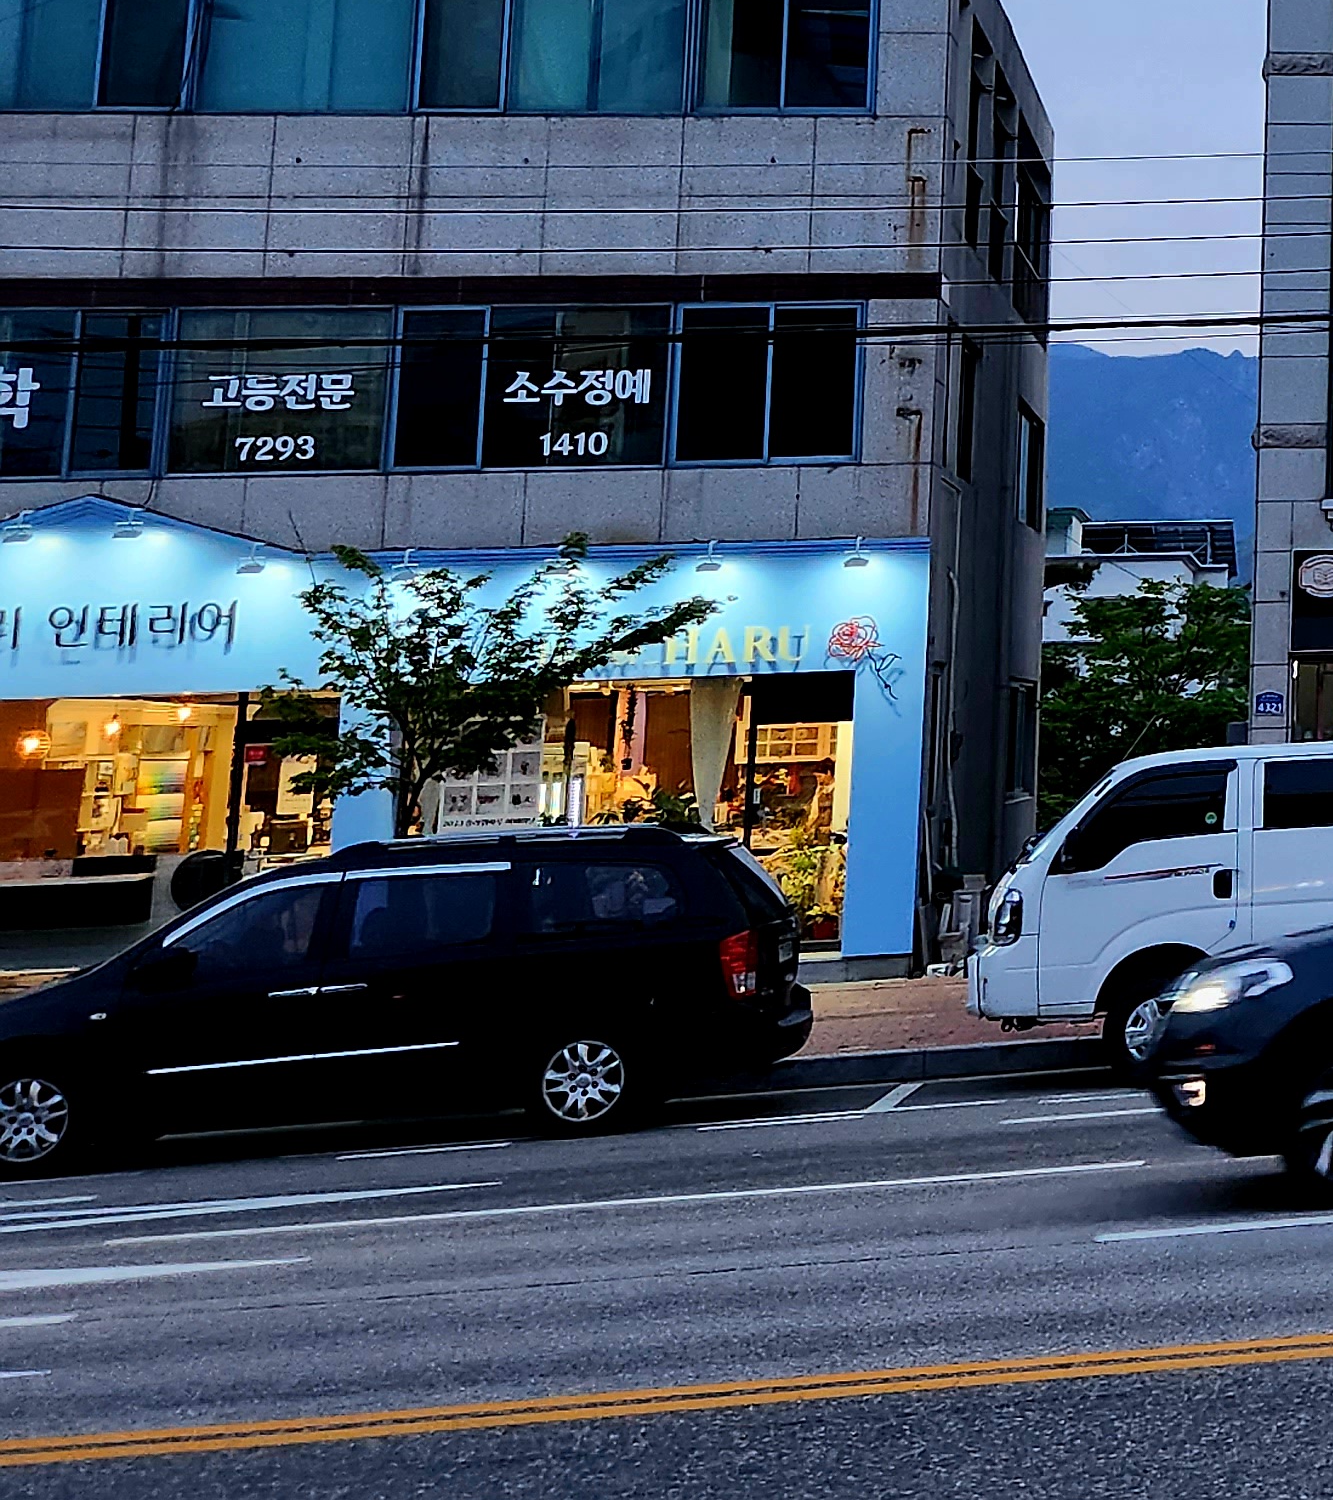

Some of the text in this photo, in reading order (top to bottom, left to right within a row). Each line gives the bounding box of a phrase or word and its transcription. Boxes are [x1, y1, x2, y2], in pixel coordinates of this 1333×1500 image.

[202, 373, 355, 411] 고등전문
[503, 369, 651, 406] 소수정예
[235, 435, 315, 461] 7293
[540, 432, 608, 457] 1410
[48, 600, 238, 648] 인테리어
[666, 625, 810, 665] HARU
